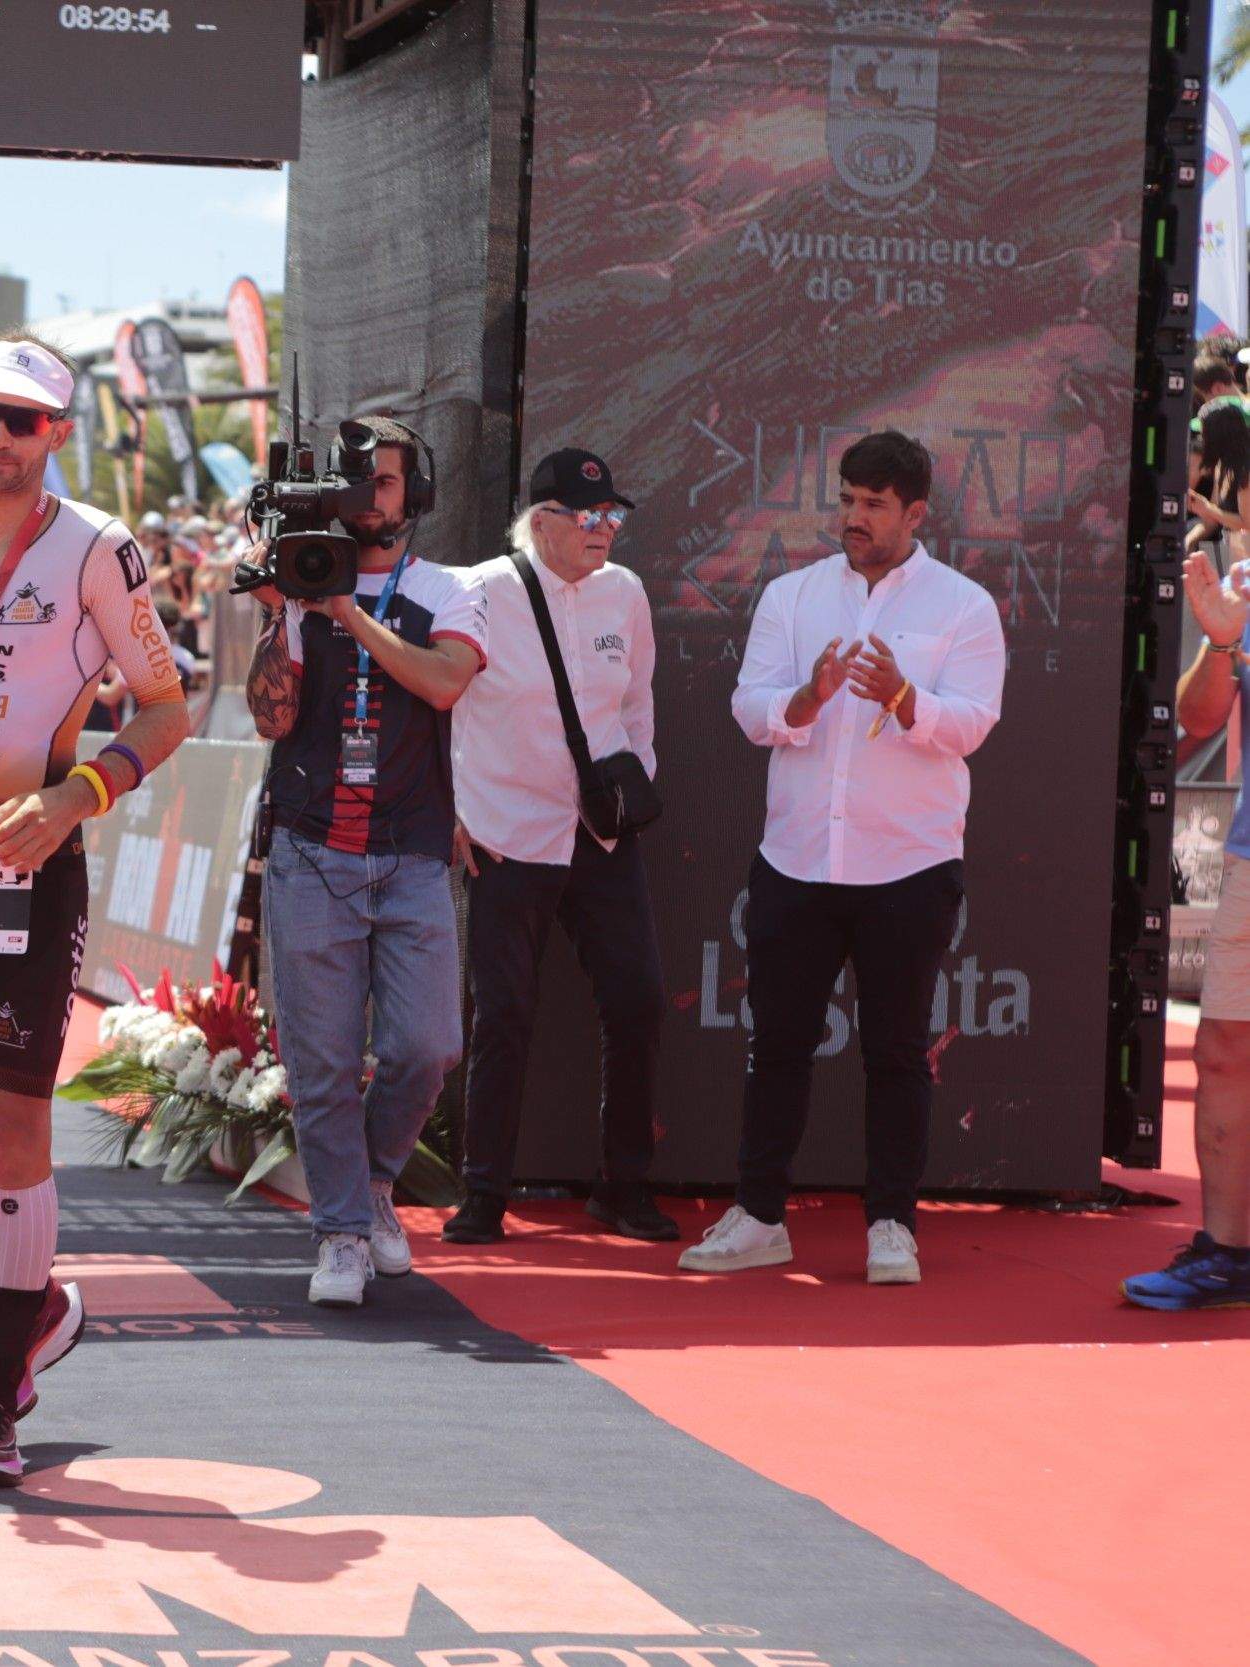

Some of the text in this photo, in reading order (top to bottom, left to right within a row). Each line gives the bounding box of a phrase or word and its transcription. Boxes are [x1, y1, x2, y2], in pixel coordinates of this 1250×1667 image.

[59, 4, 171, 33] 08:29:54
[736, 220, 1018, 272] Ayuntamiento
[805, 268, 853, 301] de
[131, 595, 172, 680] zoetis
